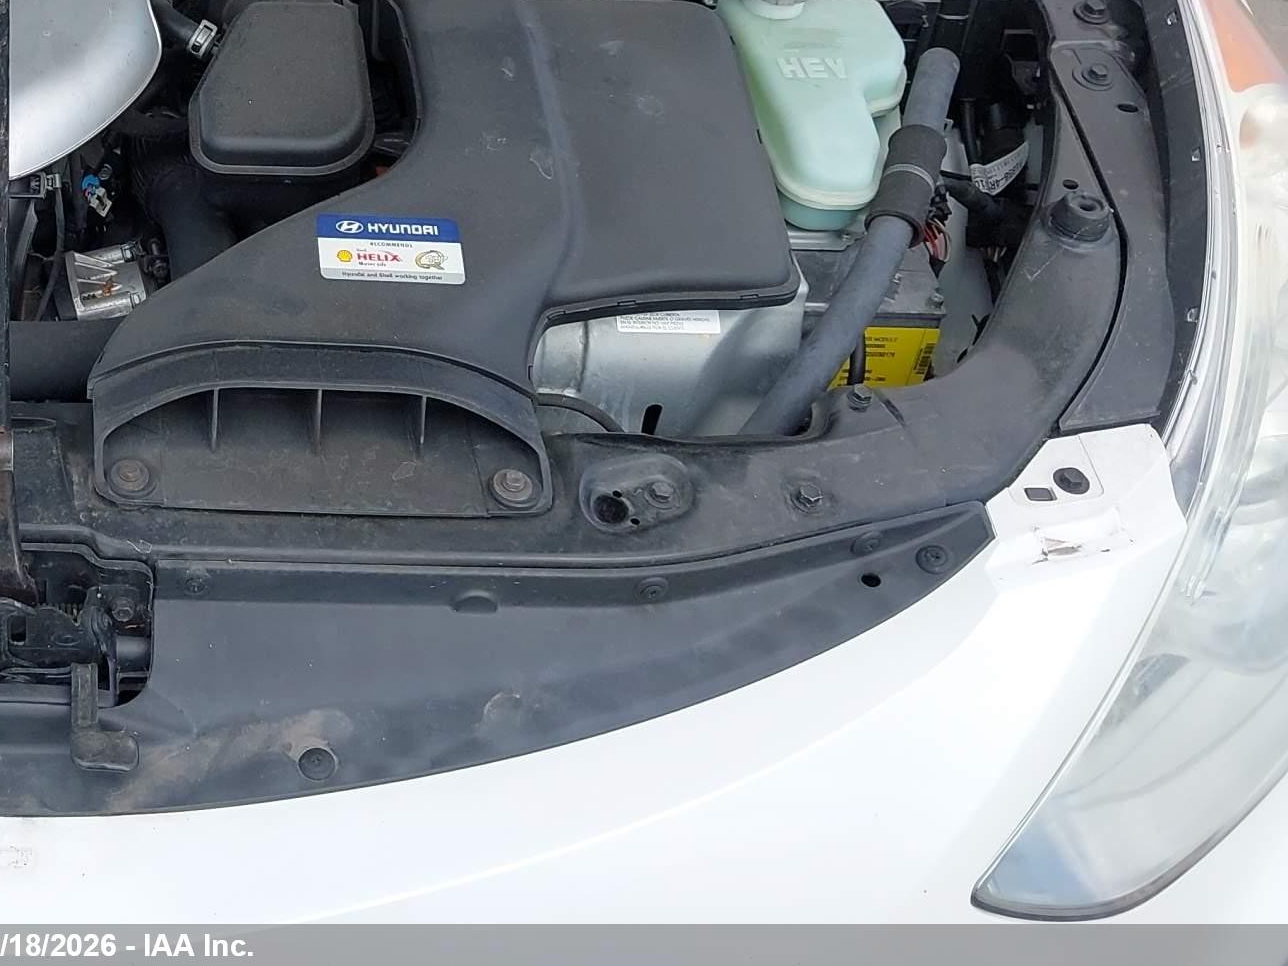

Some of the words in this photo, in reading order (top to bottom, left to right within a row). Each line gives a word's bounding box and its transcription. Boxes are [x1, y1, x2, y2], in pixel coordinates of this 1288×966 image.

[775, 57, 848, 79] HEV
[367, 223, 440, 236] HYUNDAI
[357, 252, 402, 262] HELIX
